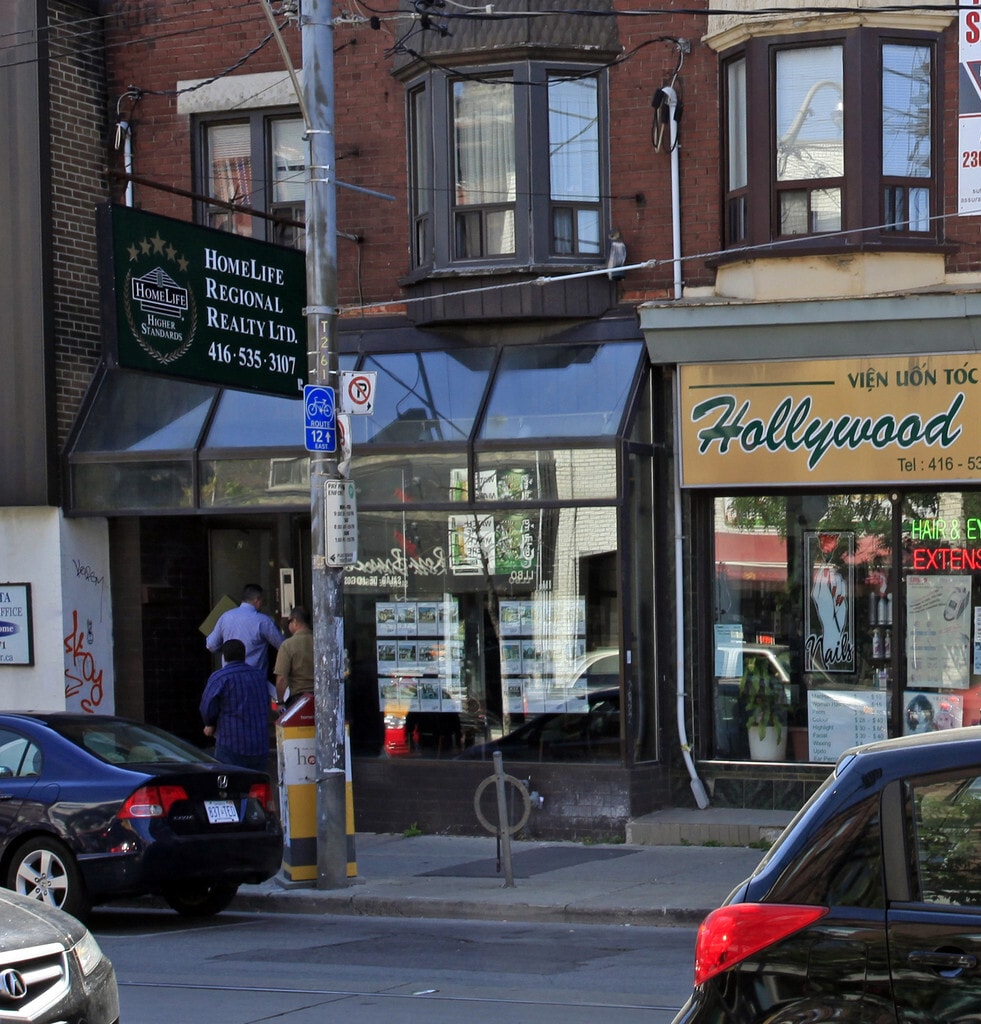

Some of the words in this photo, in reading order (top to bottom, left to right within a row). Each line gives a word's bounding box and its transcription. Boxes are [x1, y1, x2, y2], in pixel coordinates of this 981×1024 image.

[205, 277, 284, 314] REGIONAL
[206, 306, 266, 338] REALTY
[848, 367, 889, 392] VIỆN
[943, 362, 979, 386] TÓC
[310, 420, 331, 428] ROUTE
[311, 430, 323, 443] 12
[690, 392, 966, 472] Hollywood
[928, 456, 954, 472] 416
[911, 517, 946, 540] HAIR
[950, 517, 961, 539] &
[805, 632, 853, 670] Nails
